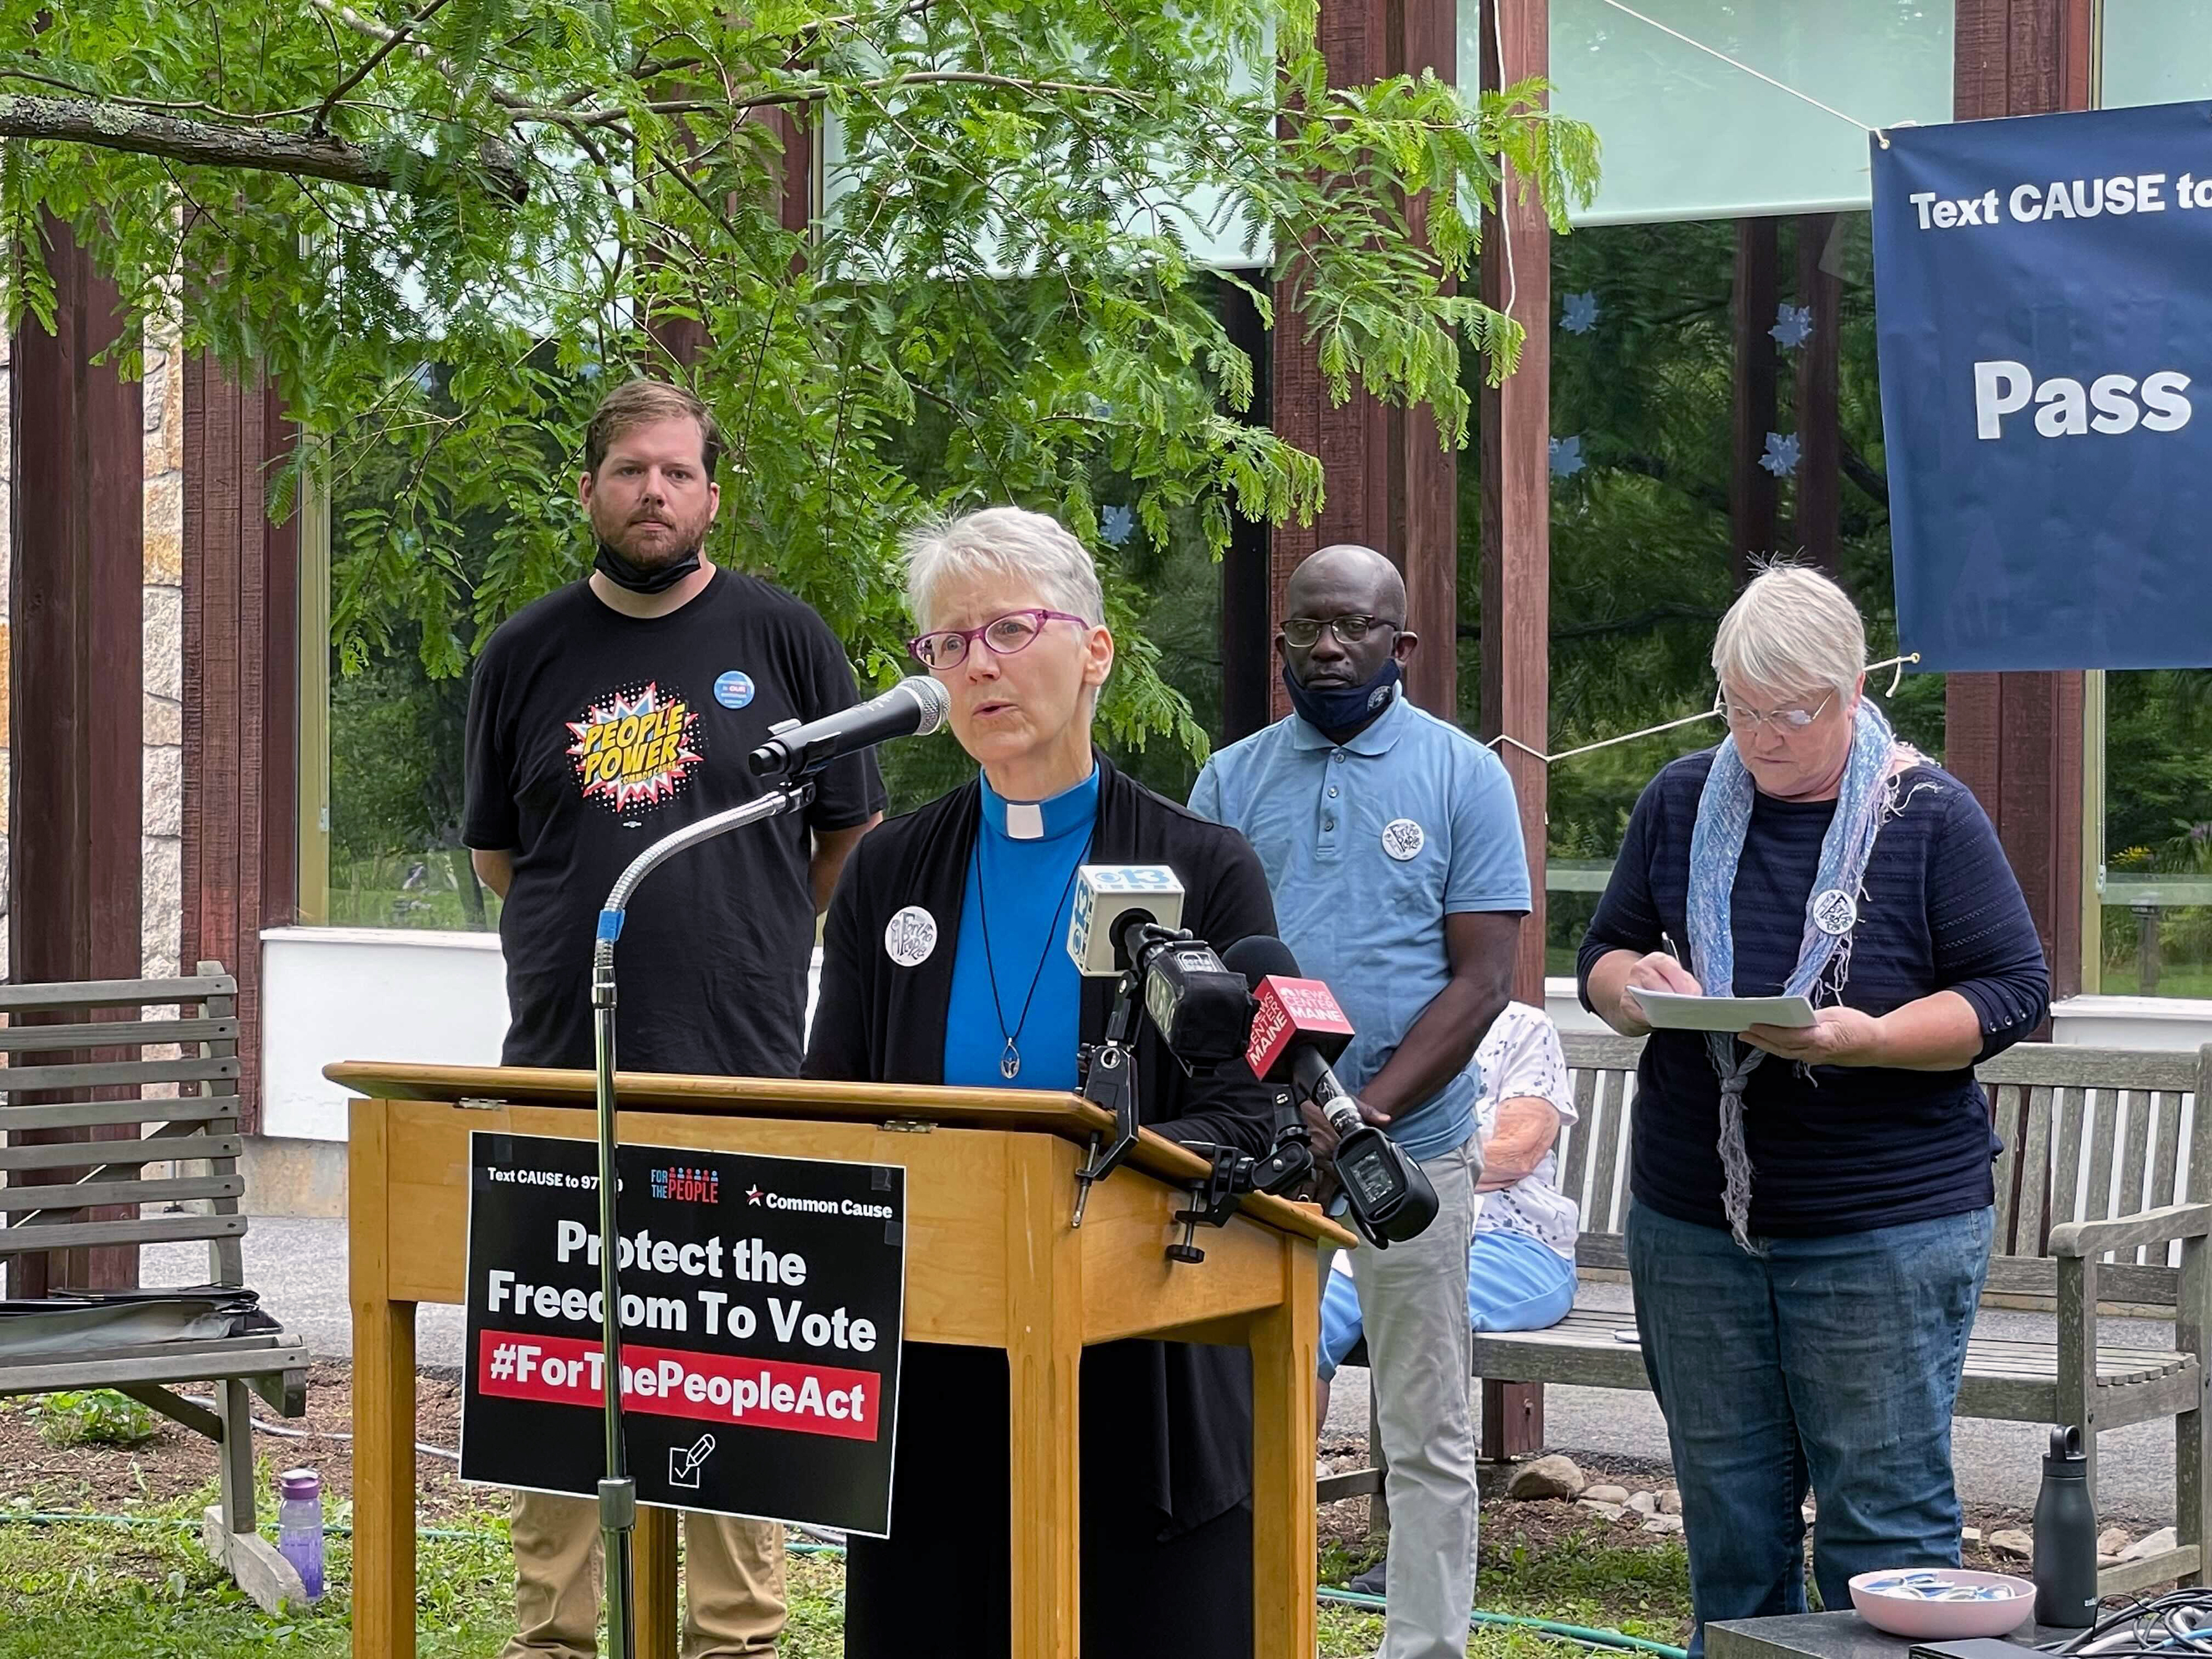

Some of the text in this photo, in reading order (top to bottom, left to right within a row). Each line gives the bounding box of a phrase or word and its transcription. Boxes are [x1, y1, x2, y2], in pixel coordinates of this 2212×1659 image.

[1910, 189, 1999, 229] Text
[2009, 174, 2165, 222] CAUSE
[1974, 360, 2192, 439] Pass
[584, 704, 686, 756] PEOPLE
[584, 734, 680, 785] POWER
[1118, 869, 1170, 884] 13
[1250, 1010, 1287, 1066] MAINE
[1290, 1006, 1344, 1022] MAINE
[488, 1167, 516, 1183] Text
[517, 1170, 563, 1187] CAUSE
[565, 1174, 579, 1189] to
[651, 1169, 668, 1183] FOR
[652, 1179, 718, 1204] THE PEOPLE
[766, 1193, 893, 1218] Common Cause
[734, 1238, 807, 1287] the
[697, 1290, 756, 1339] To
[767, 1297, 877, 1352] Vote
